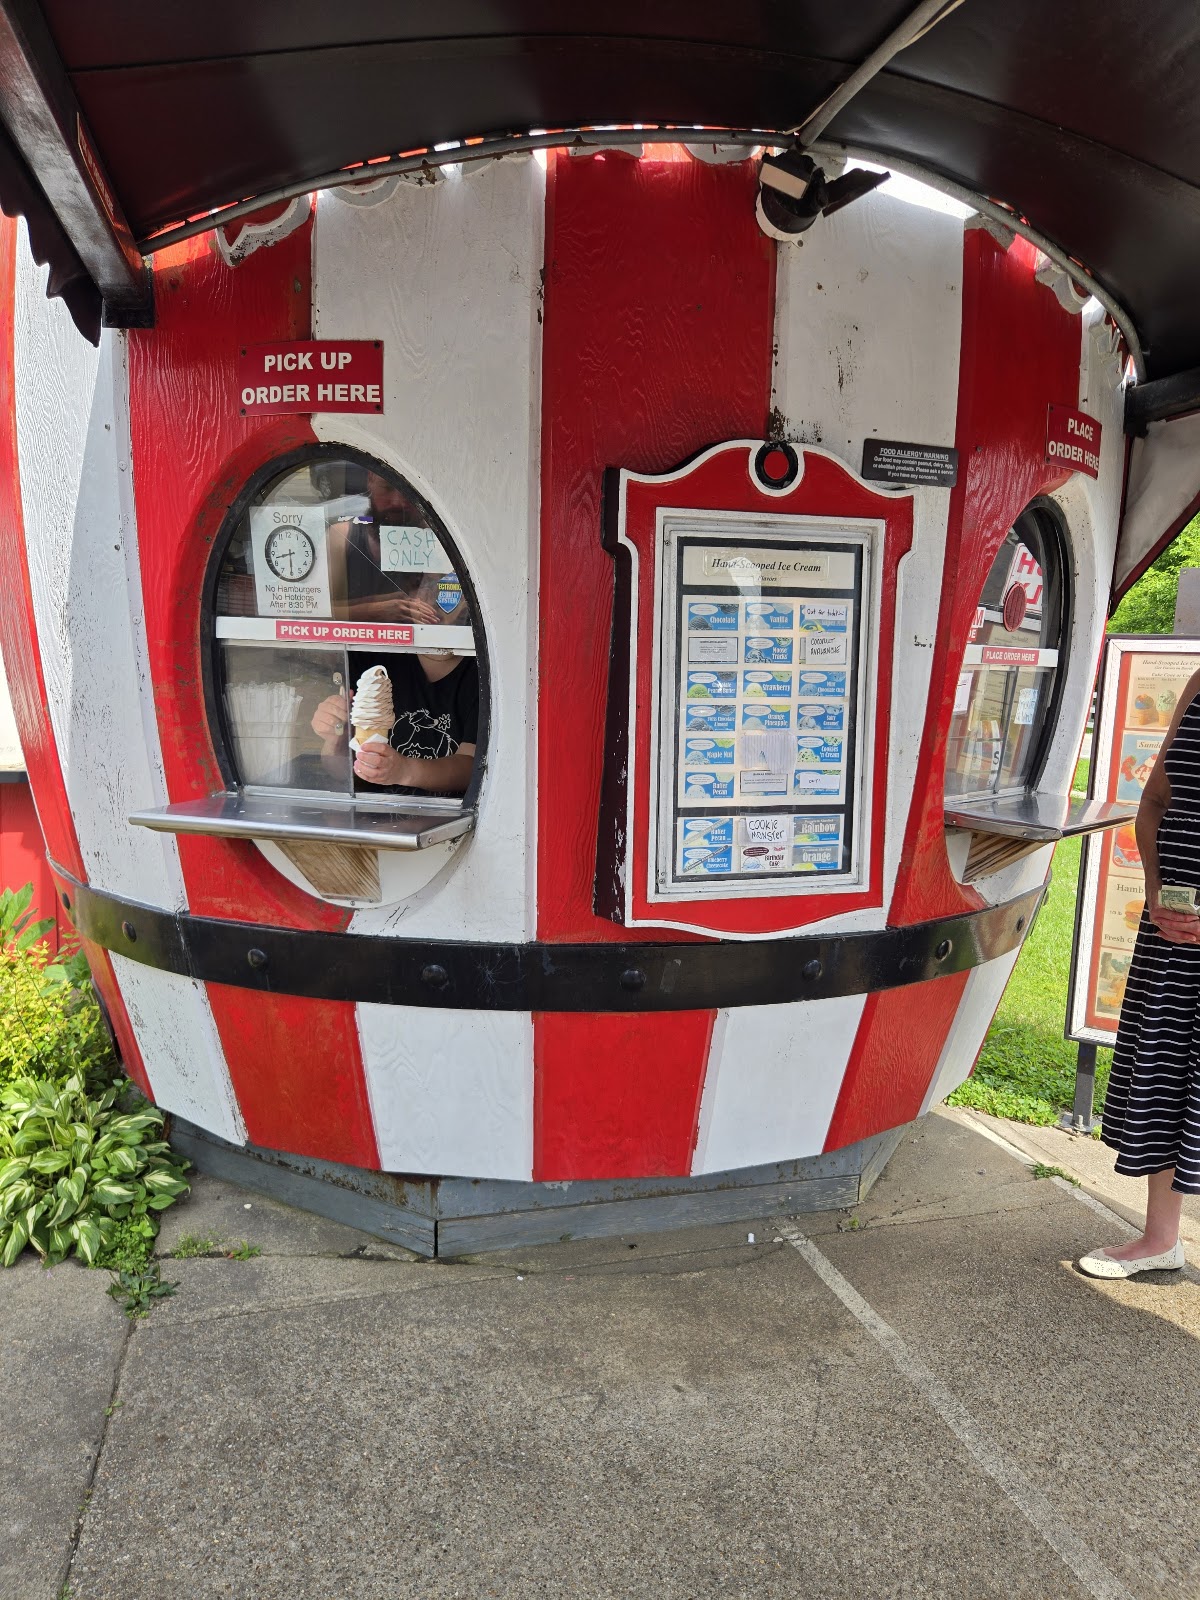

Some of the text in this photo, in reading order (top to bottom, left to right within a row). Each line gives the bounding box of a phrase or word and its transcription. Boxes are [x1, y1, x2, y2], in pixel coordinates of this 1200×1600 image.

[264, 352, 353, 373] PICK UP
[241, 384, 381, 406] ORDER HERE
[1067, 417, 1094, 442] PLACE
[879, 447, 949, 461] FOOD ALLERGY WARNING
[1048, 440, 1083, 463] ORDER
[273, 511, 303, 526] Sorry
[386, 529, 437, 548] CASH
[388, 549, 433, 568] ONLY
[777, 561, 792, 571] Ice
[793, 562, 822, 572] Cream
[277, 585, 322, 594] Hamburgers
[272, 593, 315, 602] No Hotdogs
[288, 601, 304, 609] 8:30
[306, 601, 318, 609] PM
[709, 616, 736, 624] Chocolate
[280, 625, 411, 640] PICK UP ORDER HERE
[985, 650, 1036, 661] PLACE ORDER HERE
[762, 683, 790, 693] Strawberry
[706, 751, 723, 759] Maple
[801, 823, 836, 834] Rainbow
[802, 851, 831, 862] Orange
[1116, 884, 1144, 894] Hamb
[1104, 933, 1125, 943] Fresh
